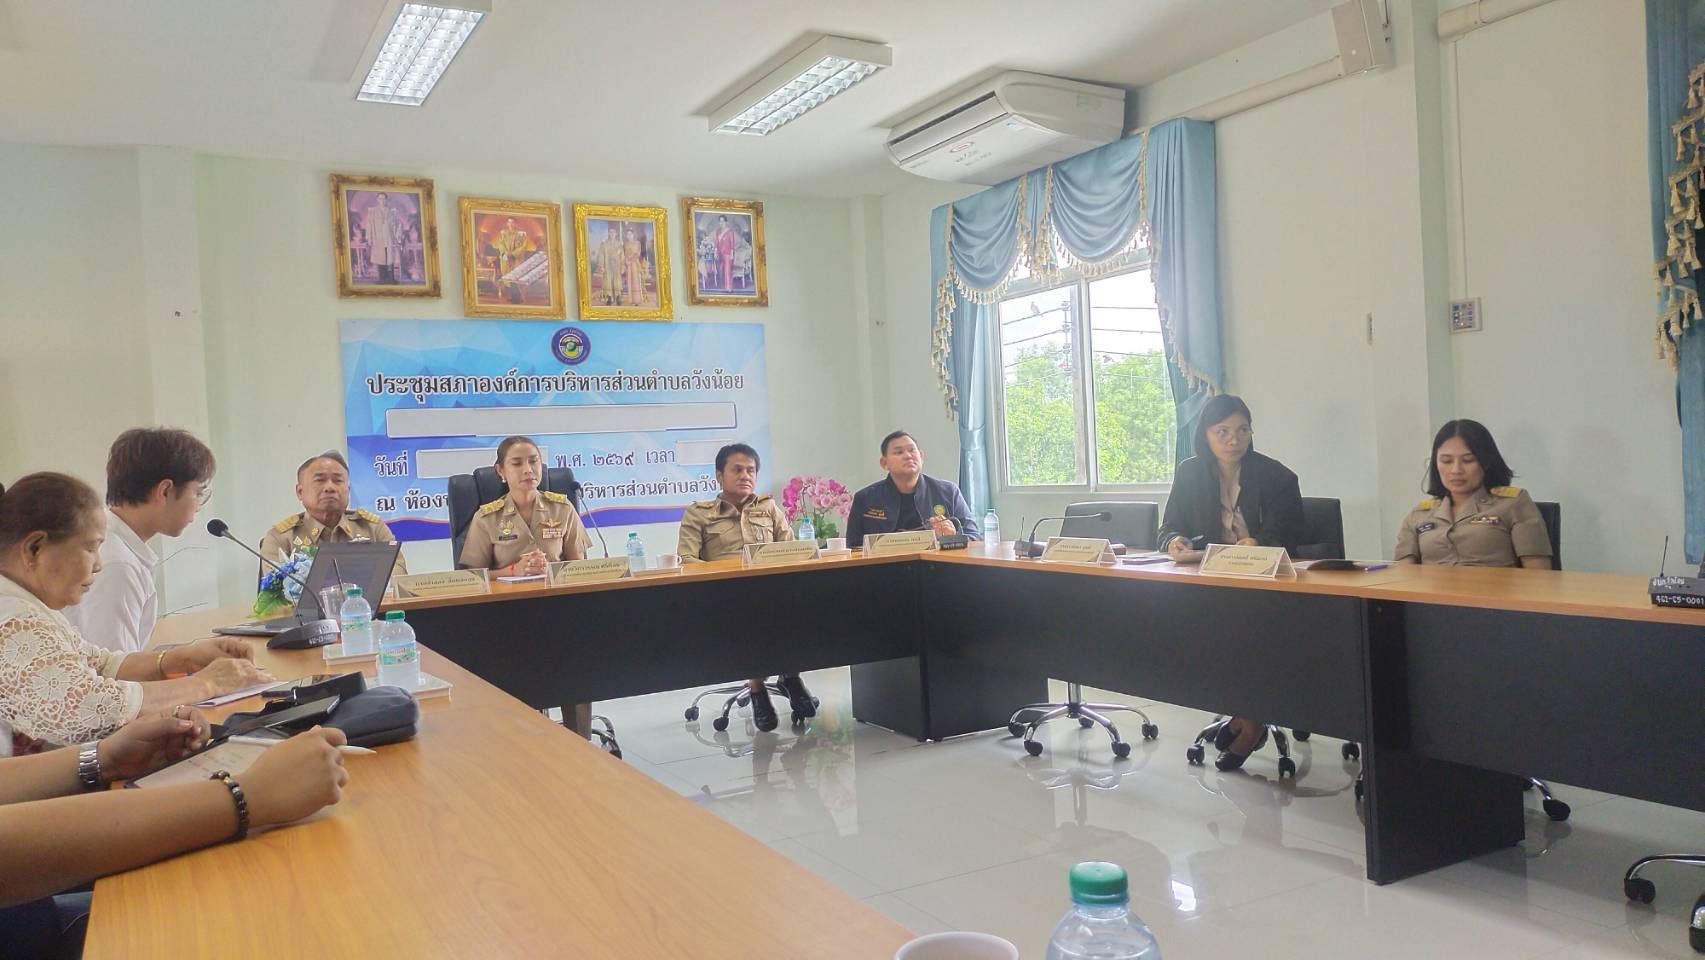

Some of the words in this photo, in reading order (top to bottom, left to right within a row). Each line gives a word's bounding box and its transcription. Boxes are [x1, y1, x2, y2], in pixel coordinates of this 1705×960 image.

[367, 369, 744, 402] ประชุมสภาองค์การบริหารส่วนตำบลวังน้อย
[374, 451, 408, 476] วันที่
[555, 454, 586, 468] พ.ศ.
[646, 450, 675, 464] เวลา
[376, 497, 396, 511] ณ
